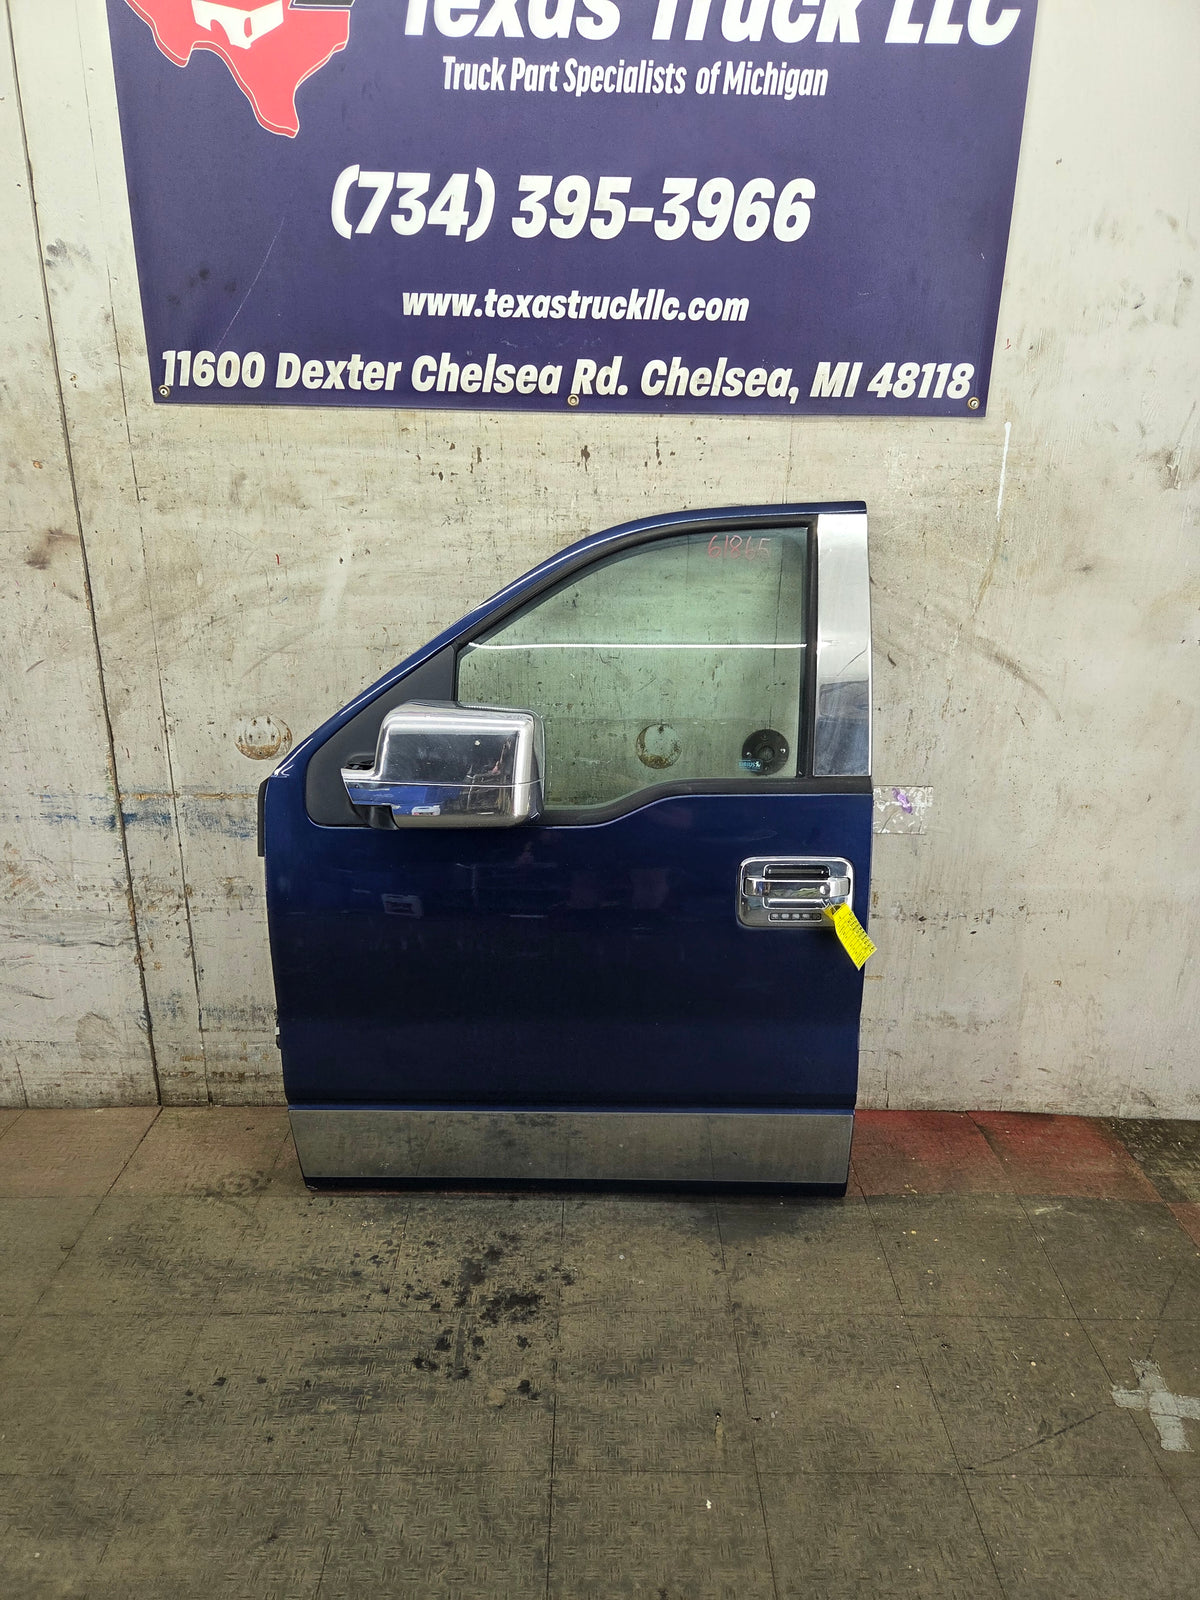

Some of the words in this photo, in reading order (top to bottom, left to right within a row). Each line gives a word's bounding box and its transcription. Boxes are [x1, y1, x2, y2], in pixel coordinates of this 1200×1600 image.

[404, 0, 621, 41] Texas
[651, 0, 862, 44] Truck
[884, 0, 1022, 46] LLC
[442, 56, 506, 91] Truck
[509, 57, 559, 92] Part
[562, 58, 688, 97] Specialists
[695, 61, 722, 95] of
[722, 60, 829, 101] Michigan
[331, 163, 496, 243] (734)
[511, 174, 816, 243] 395-3966
[402, 288, 750, 322] www.texastruckllc.com
[161, 350, 266, 388] 11600
[275, 352, 403, 391] Dexter
[411, 352, 563, 395] Chelsea
[570, 356, 628, 396] Rd.
[640, 356, 799, 404] Chelsea,
[809, 361, 863, 398] MI
[867, 362, 975, 399] 48118
